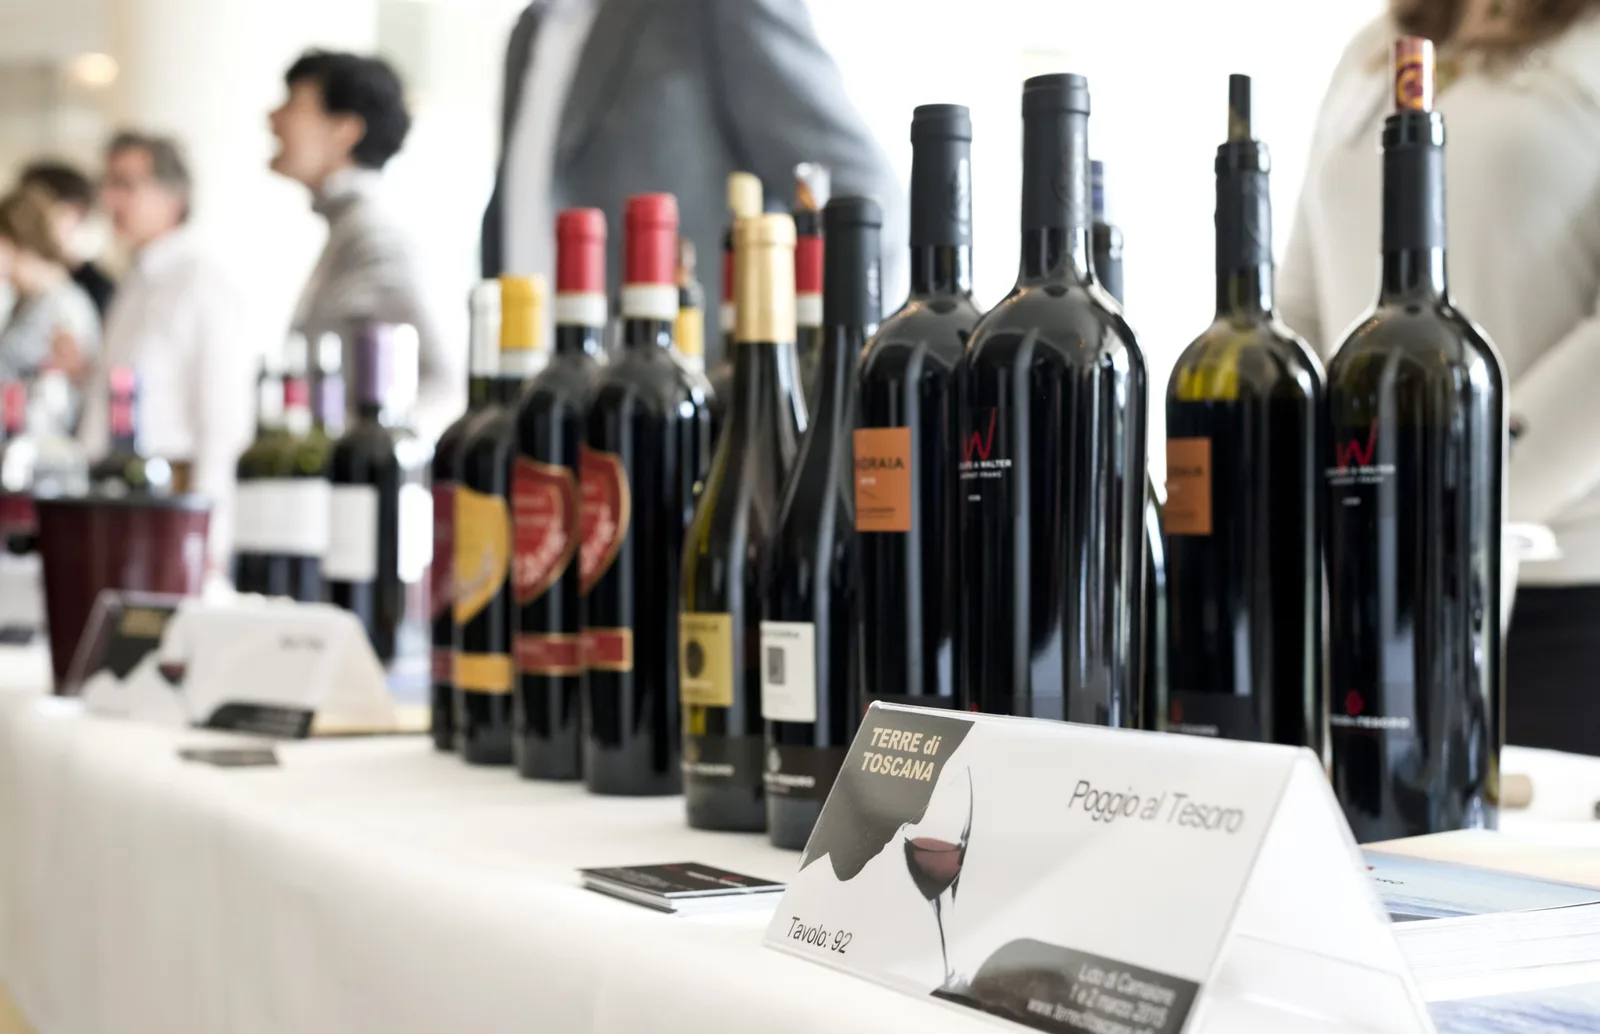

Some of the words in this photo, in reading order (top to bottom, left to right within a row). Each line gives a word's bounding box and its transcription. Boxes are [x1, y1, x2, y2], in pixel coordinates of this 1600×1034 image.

[870, 726, 924, 753] TERRE
[923, 735, 942, 756] di
[861, 751, 935, 782] TOSCANA
[1068, 780, 1140, 823] Poggio
[1140, 790, 1167, 820] al
[1167, 792, 1244, 835] Tesoro
[787, 916, 832, 949] Tavolo:
[831, 929, 853, 954] 92
